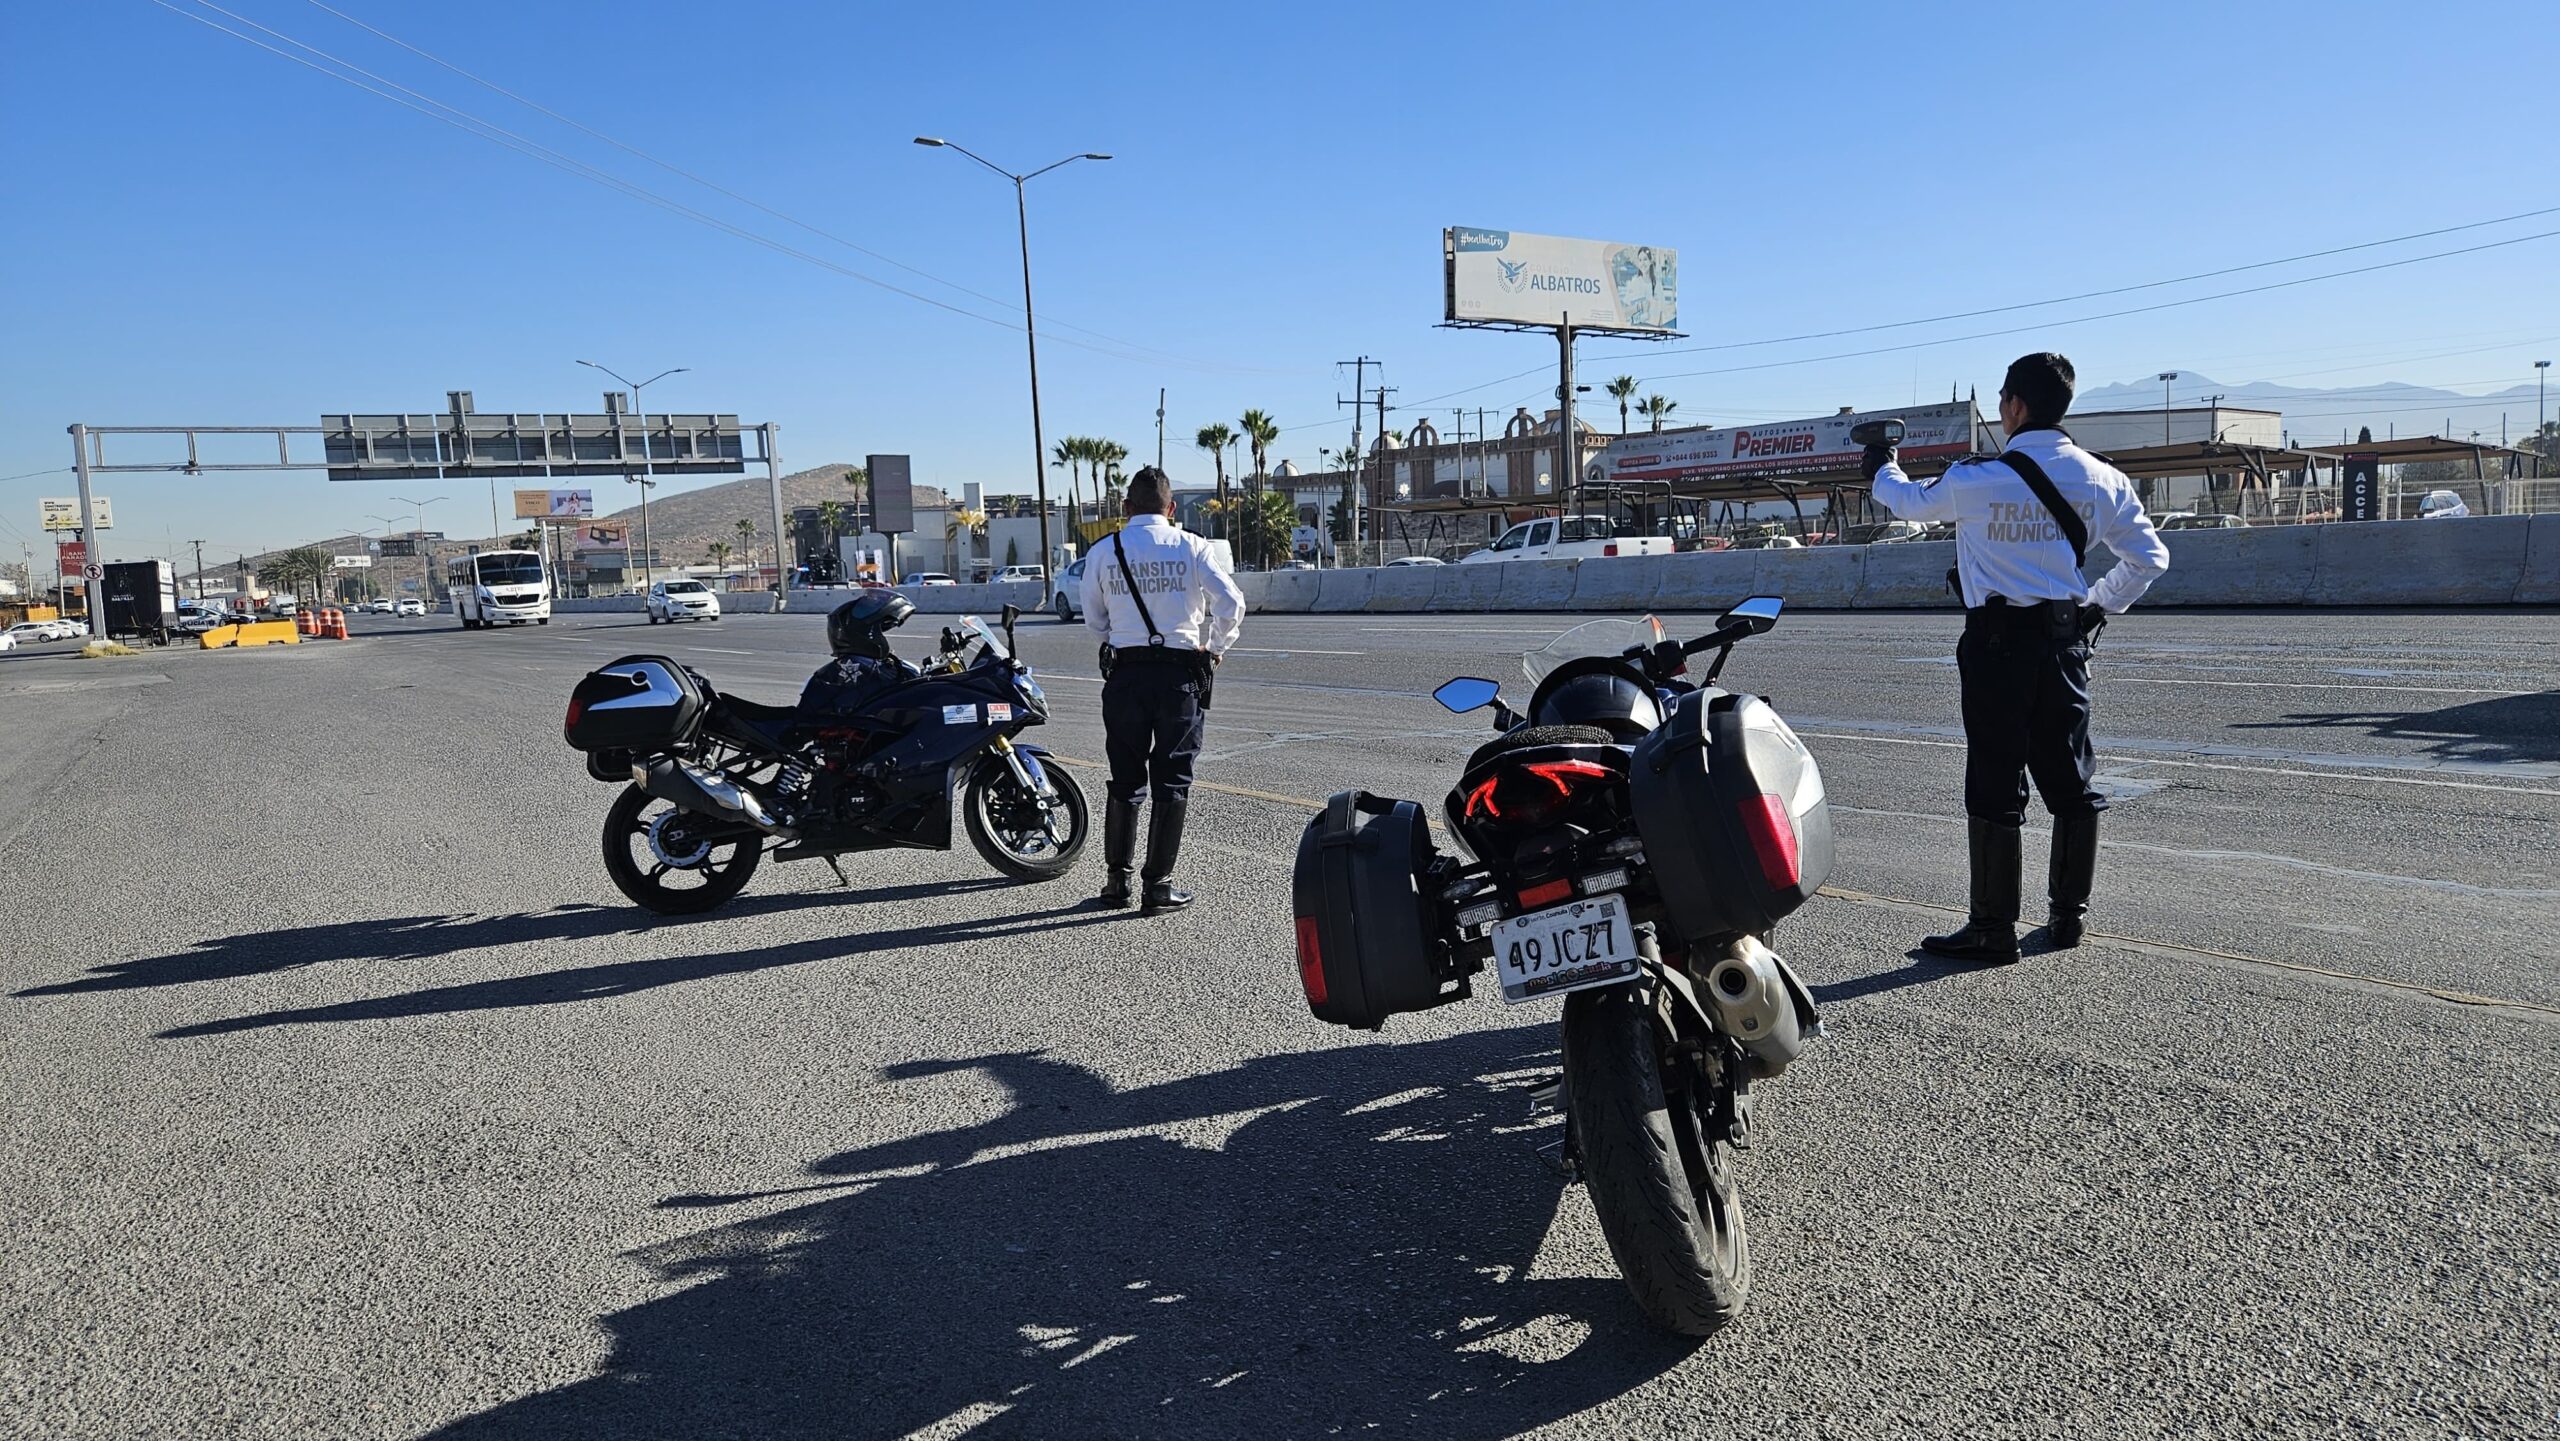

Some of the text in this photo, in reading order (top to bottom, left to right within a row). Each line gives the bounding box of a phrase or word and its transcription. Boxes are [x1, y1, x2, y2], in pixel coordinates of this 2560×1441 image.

[1530, 274, 1601, 294] ALBATROS
[1752, 429, 1780, 438] AUTOS
[1907, 429, 1945, 439] SALTILLO
[1732, 431, 1816, 459] PREMIER
[1838, 454, 1864, 462] SALTILL
[2355, 471, 2367, 519] ACCE
[1989, 498, 2096, 521] TRÁNTO
[1988, 522, 2070, 543] MUNICI
[1499, 926, 1506, 935] T
